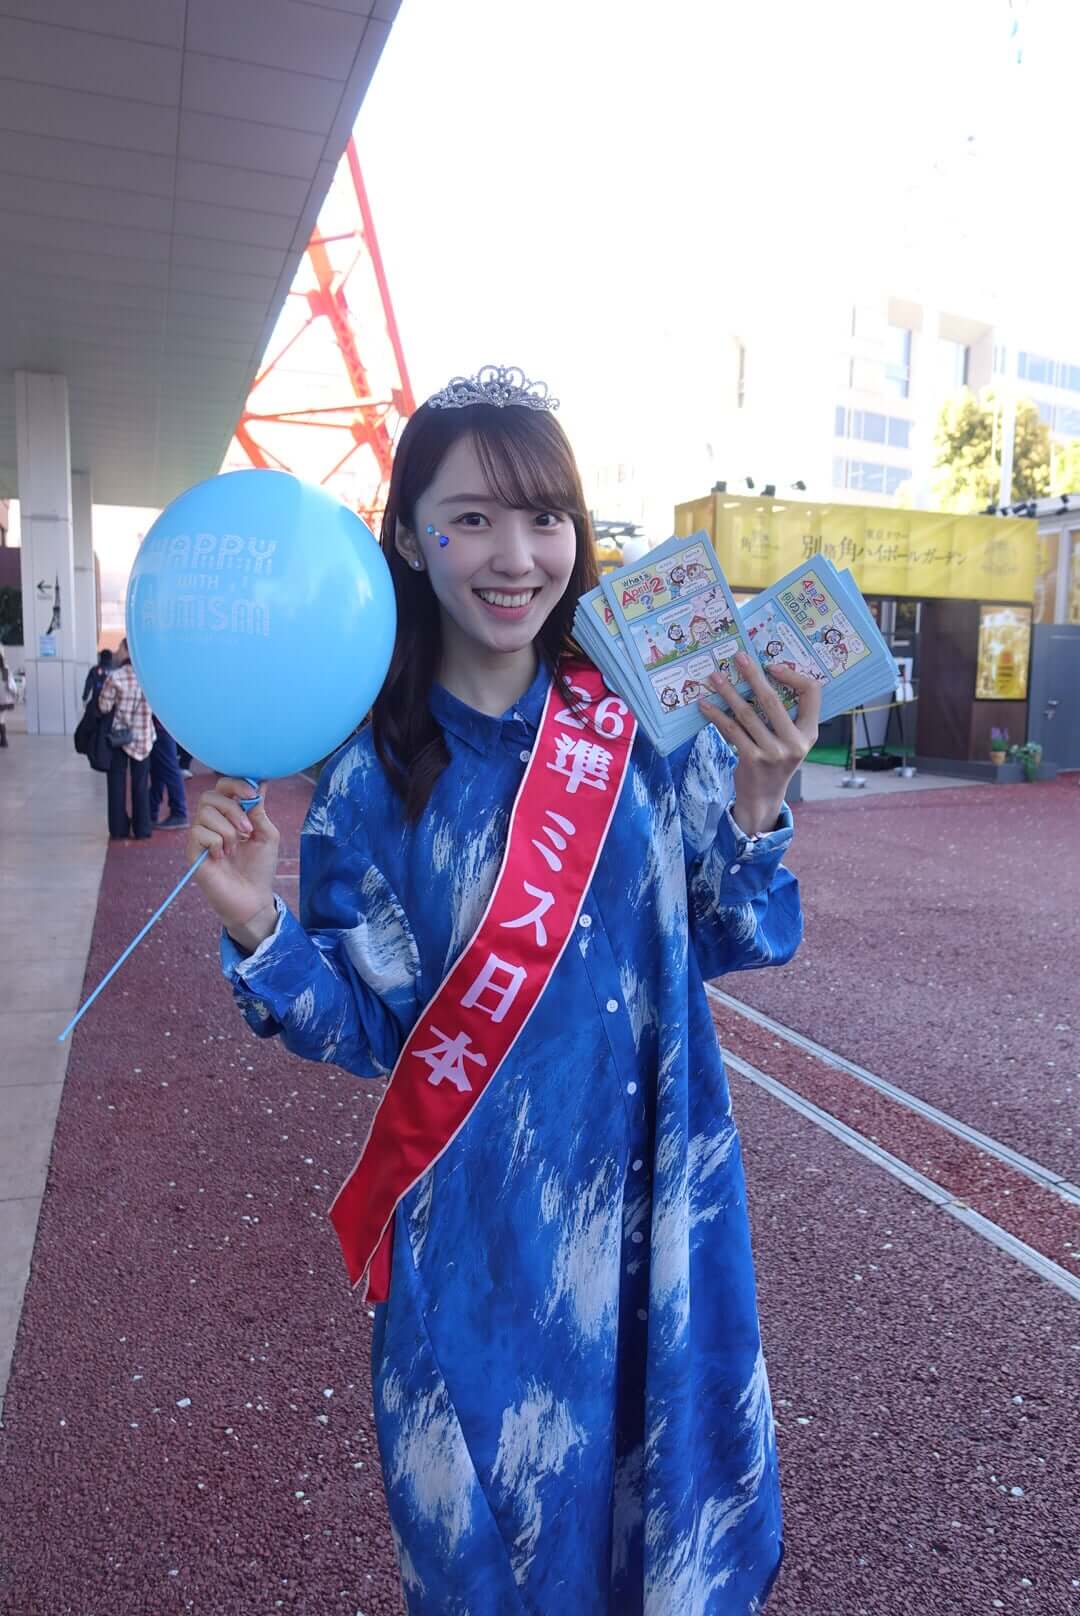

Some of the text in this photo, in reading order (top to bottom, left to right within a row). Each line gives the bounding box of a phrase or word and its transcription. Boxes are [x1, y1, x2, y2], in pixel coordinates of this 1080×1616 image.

[621, 581, 651, 608] April
[649, 575, 665, 593] 2
[802, 580, 829, 614] 4月2日
